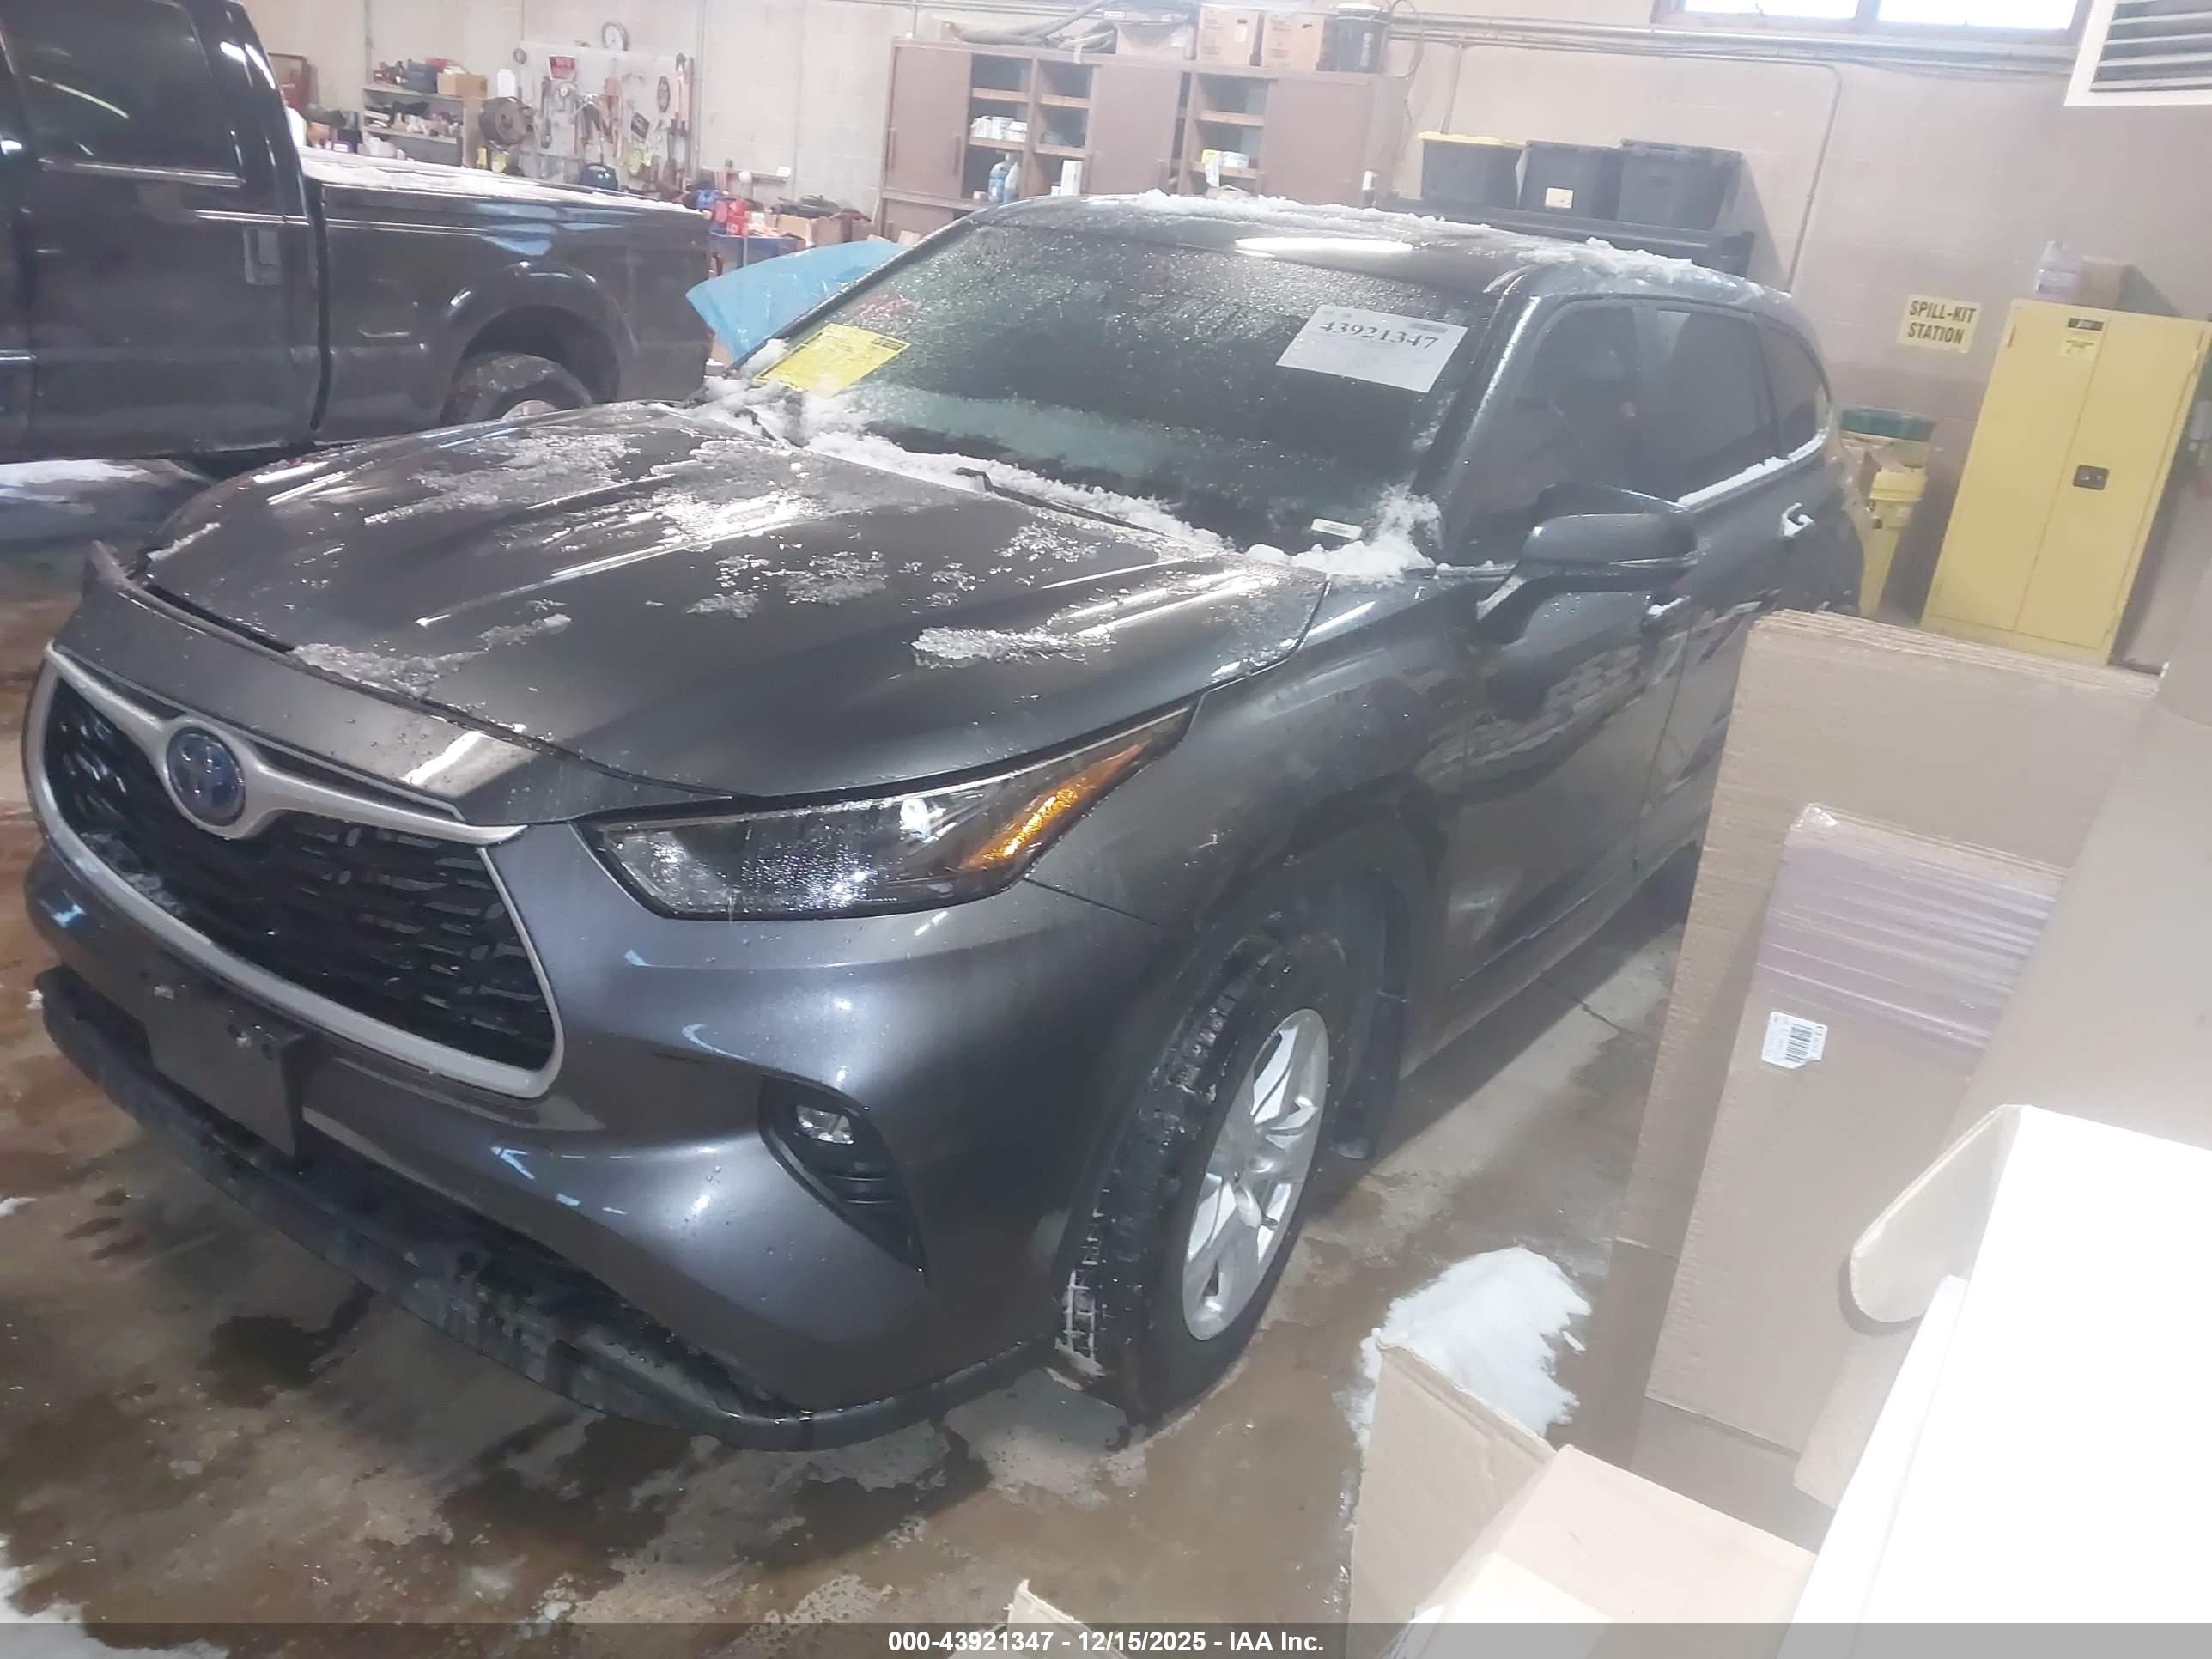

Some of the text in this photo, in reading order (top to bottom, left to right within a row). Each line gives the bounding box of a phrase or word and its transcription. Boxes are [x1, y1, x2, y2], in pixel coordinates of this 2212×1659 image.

[1909, 300, 1977, 323] SPILL-KIT
[1319, 321, 1439, 349] 43921347
[1908, 322, 1966, 344] STATION
